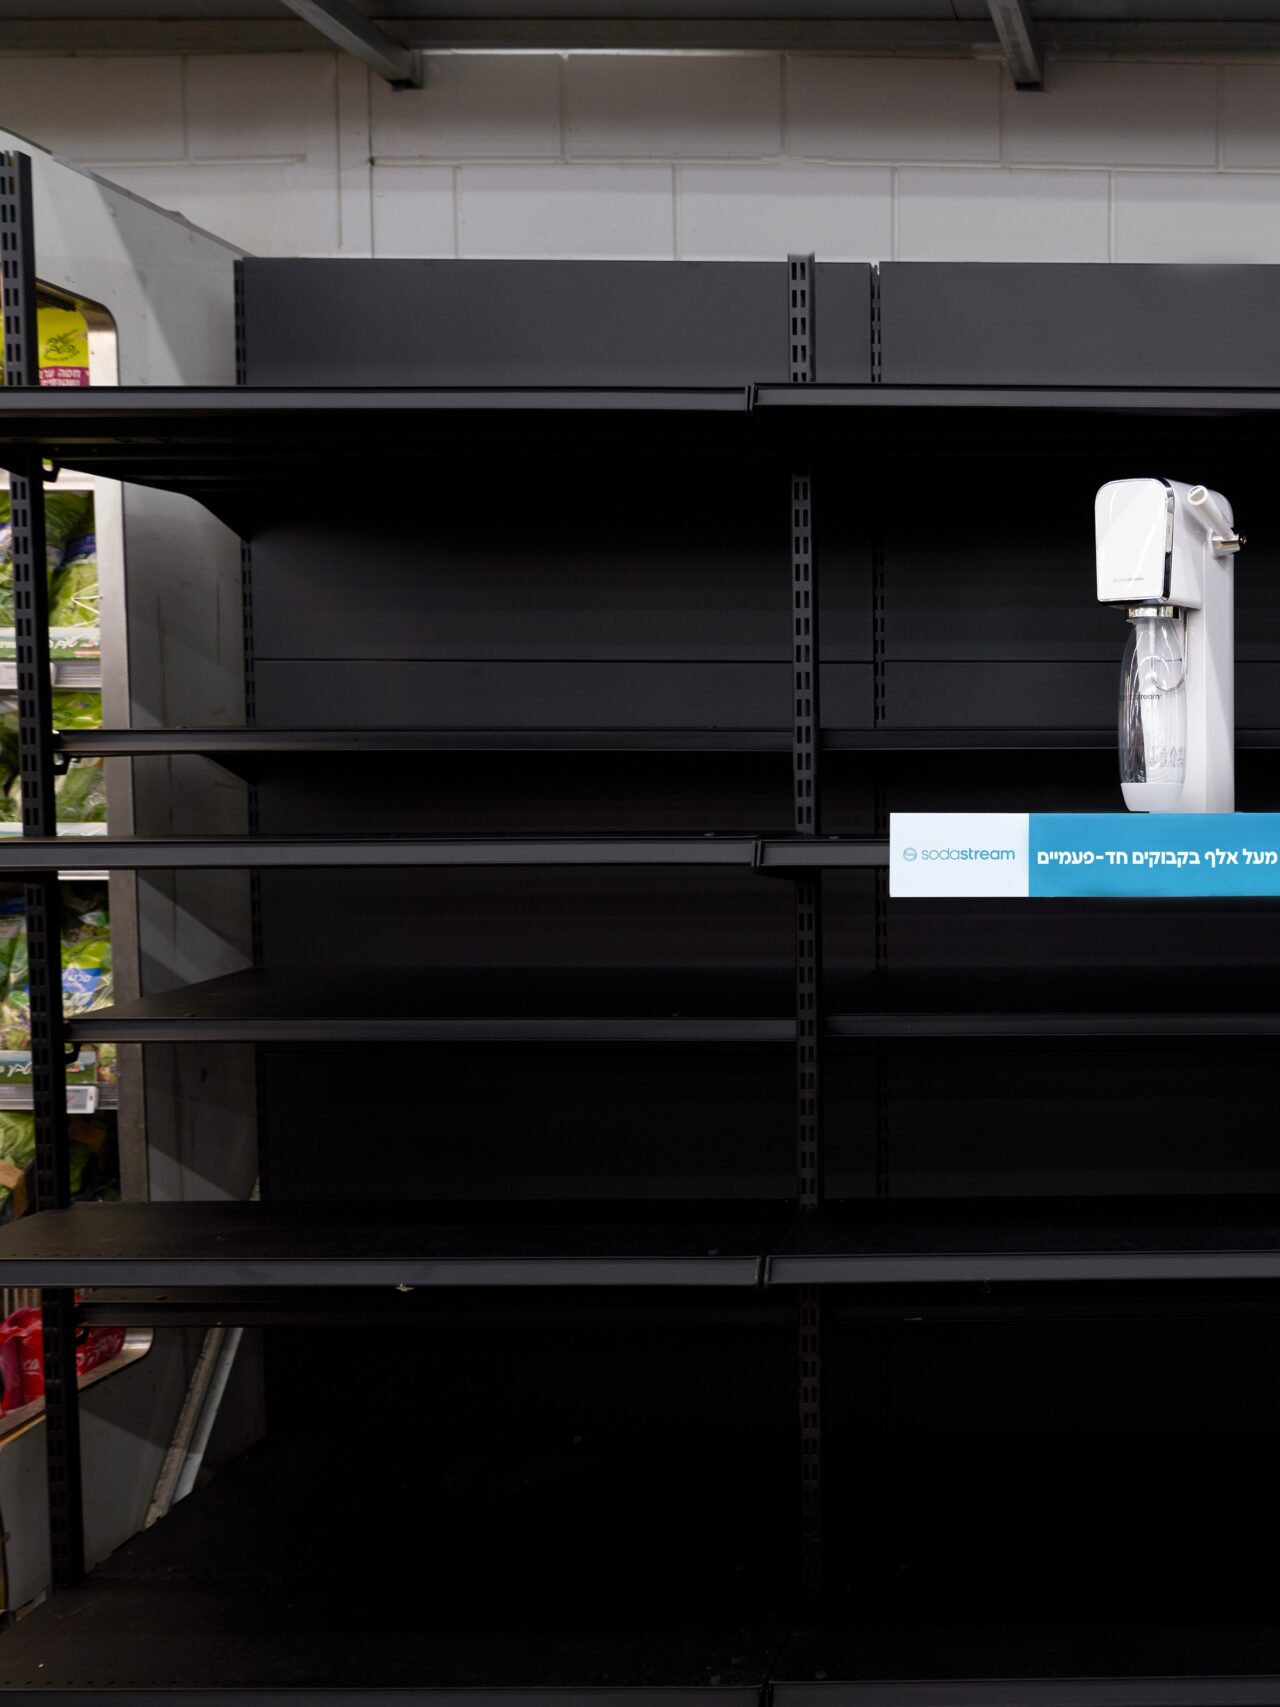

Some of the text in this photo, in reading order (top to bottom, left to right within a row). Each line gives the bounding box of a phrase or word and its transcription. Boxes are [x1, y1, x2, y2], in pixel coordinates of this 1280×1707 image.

[921, 847, 1016, 861] sodastream
[1037, 850, 1129, 865] חד-פעמיים
[1131, 851, 1201, 868] בקבוקים
[1204, 848, 1239, 868] אלף
[1242, 848, 1278, 865] מעל
